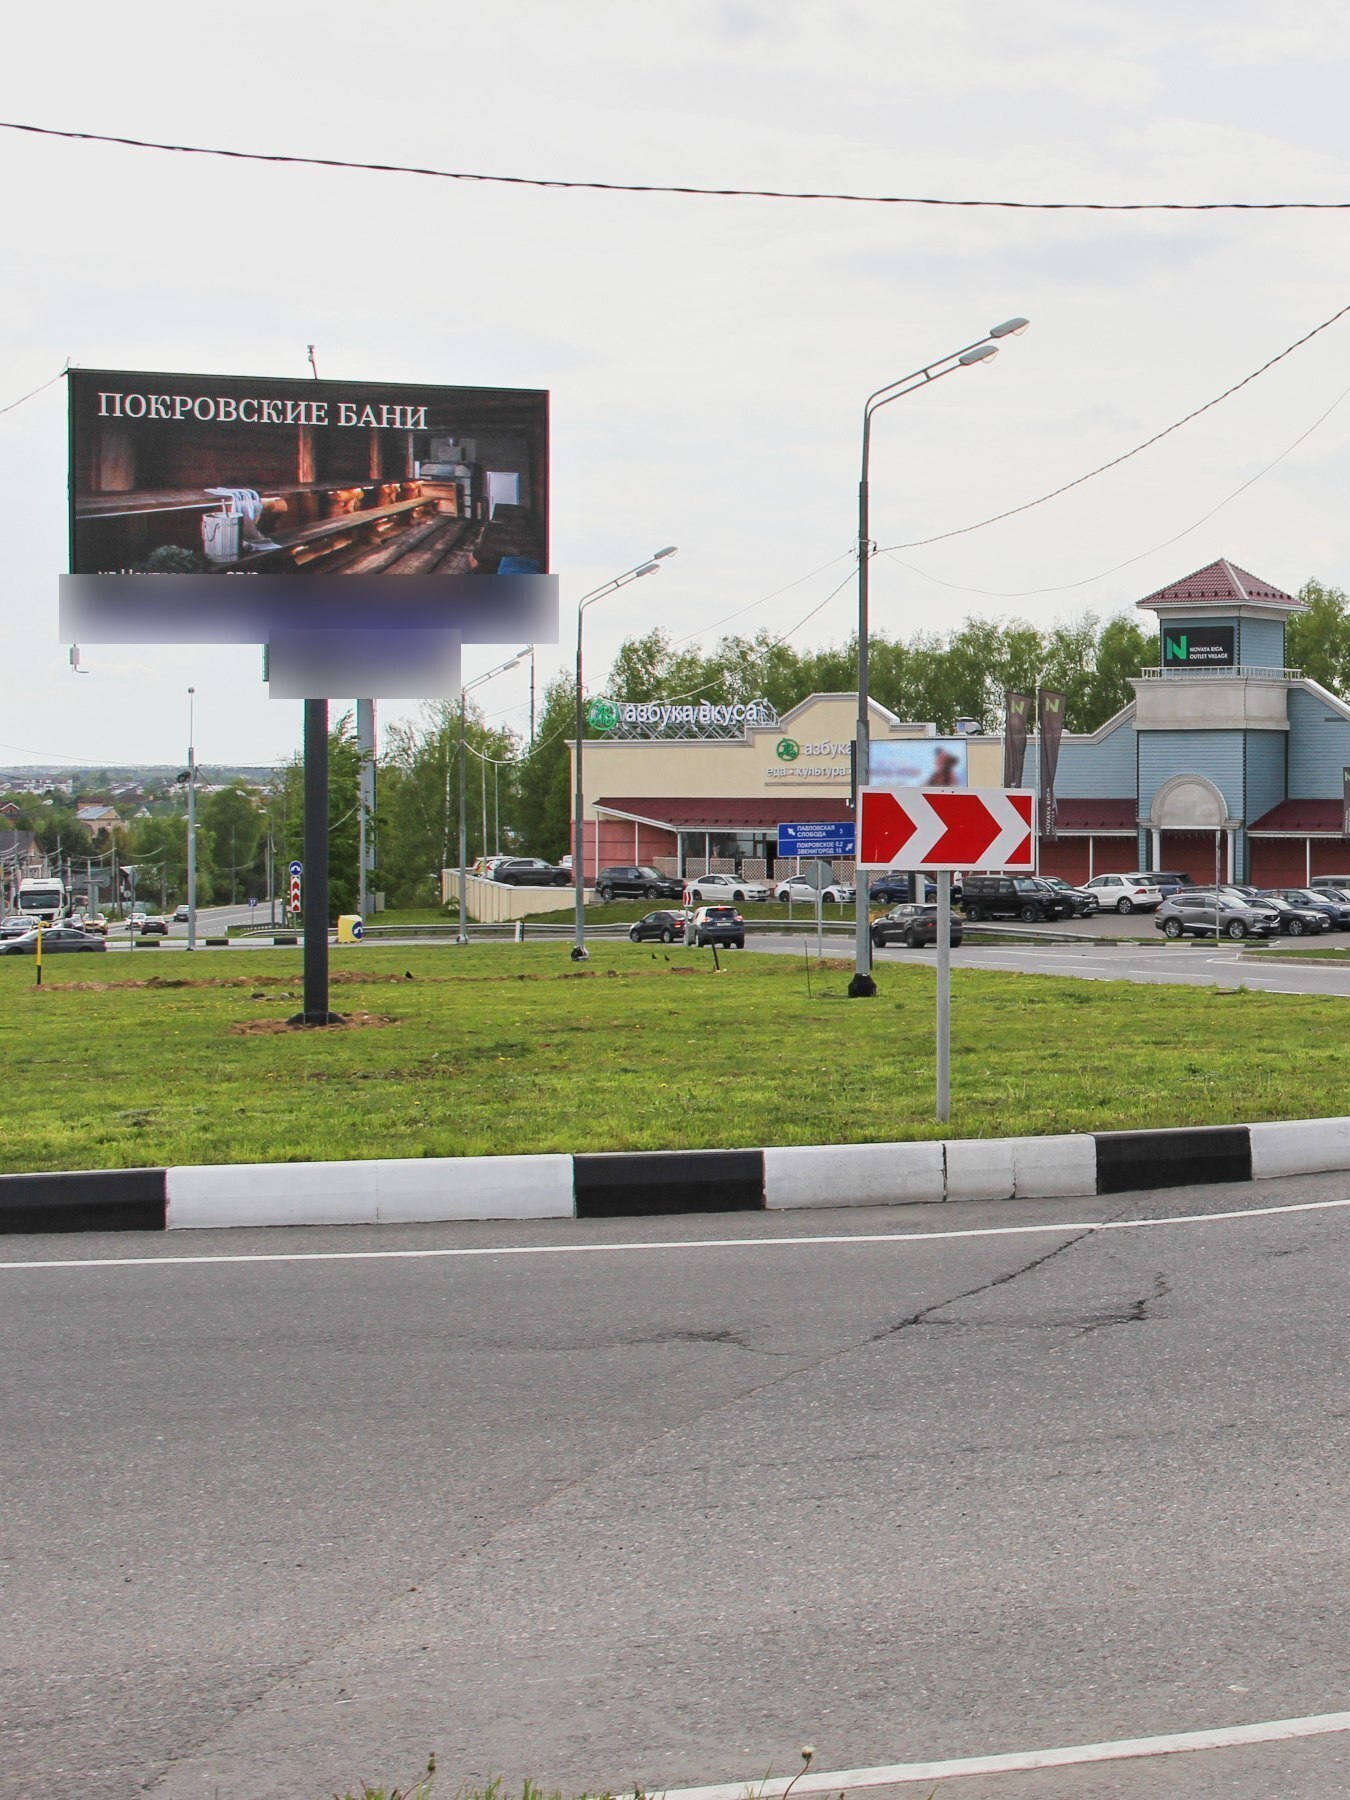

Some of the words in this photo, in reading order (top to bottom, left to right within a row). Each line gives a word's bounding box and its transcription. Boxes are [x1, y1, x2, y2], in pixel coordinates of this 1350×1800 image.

[97, 392, 329, 426] ПОКРОВСКИЕ
[337, 403, 429, 430] БАНИ
[626, 700, 695, 727] азбука
[699, 698, 758, 727] вкуса
[767, 766, 786, 777] еда
[796, 767, 846, 779] культура
